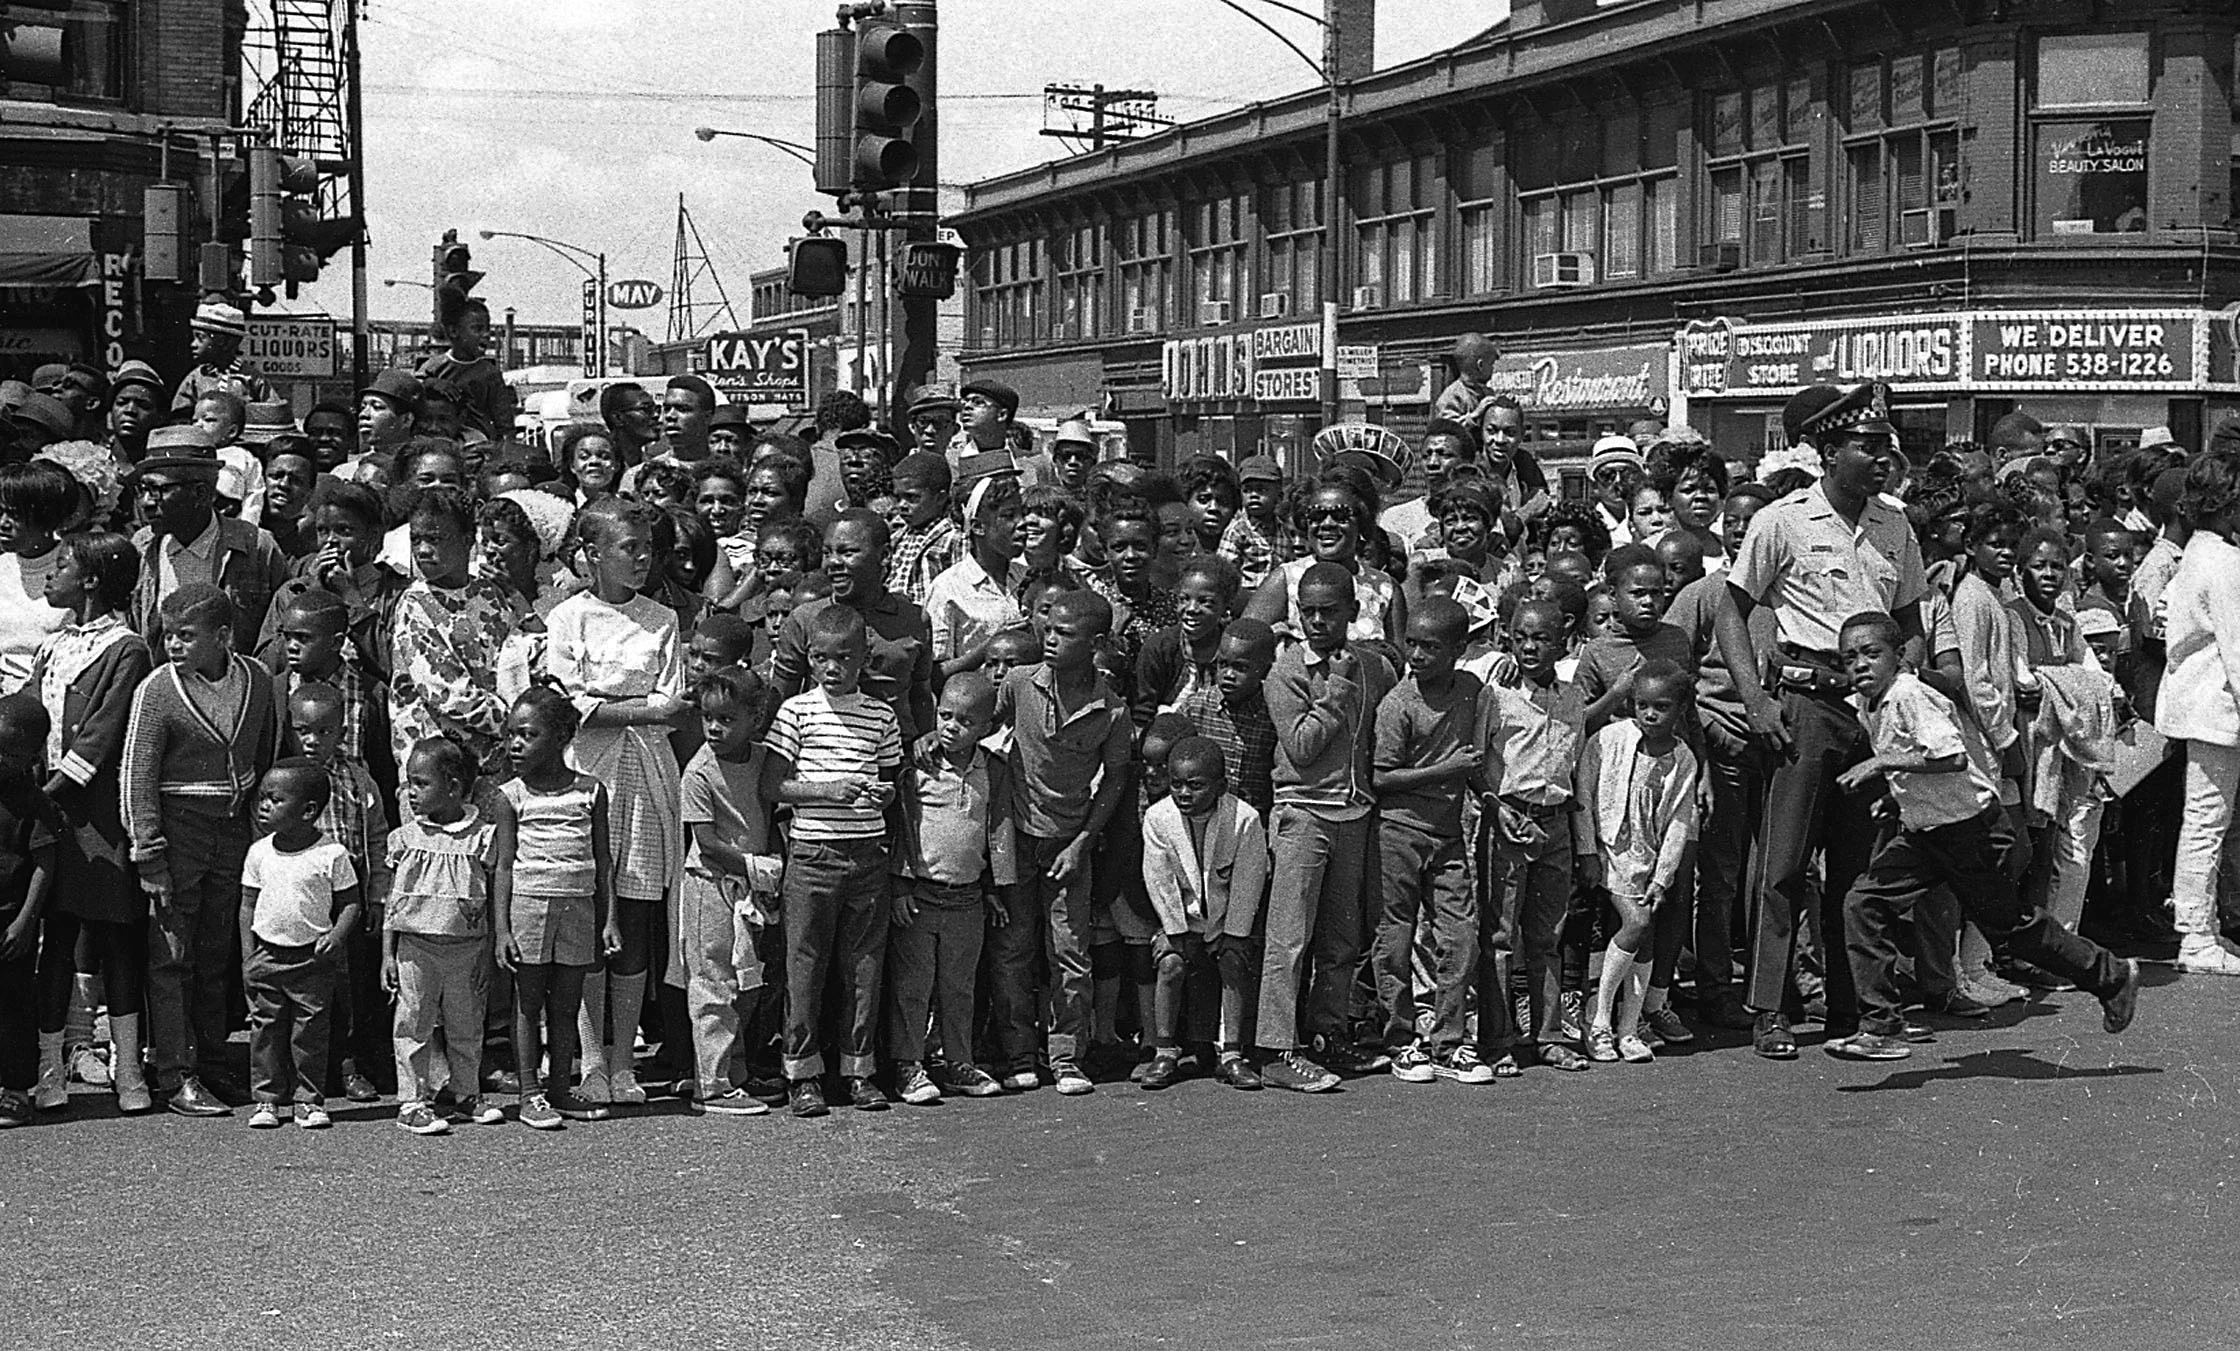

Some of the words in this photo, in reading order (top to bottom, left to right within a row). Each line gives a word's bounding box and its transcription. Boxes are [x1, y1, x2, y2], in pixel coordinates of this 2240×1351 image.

[2049, 160, 2099, 173] BEAUTY
[2103, 159, 2144, 172] SALON
[904, 270, 948, 288] WALK
[613, 284, 657, 304] MAY
[249, 325, 331, 338] CUT-RATE
[1256, 327, 1314, 356] BARGAIN
[2001, 325, 2038, 348] WE
[2049, 323, 2165, 348] DELIVER
[250, 340, 331, 358] LIQUORS
[711, 337, 799, 370] KAY'S
[1737, 333, 1812, 356] DISCOUNT
[1838, 328, 1951, 380] LIQUORS
[1747, 363, 1799, 384] STORE
[1985, 353, 2056, 376] PHONE
[2065, 352, 2174, 376] 538-1226
[753, 372, 800, 389] Shops
[1256, 371, 1313, 398] STORES
[773, 393, 802, 402] HATS
